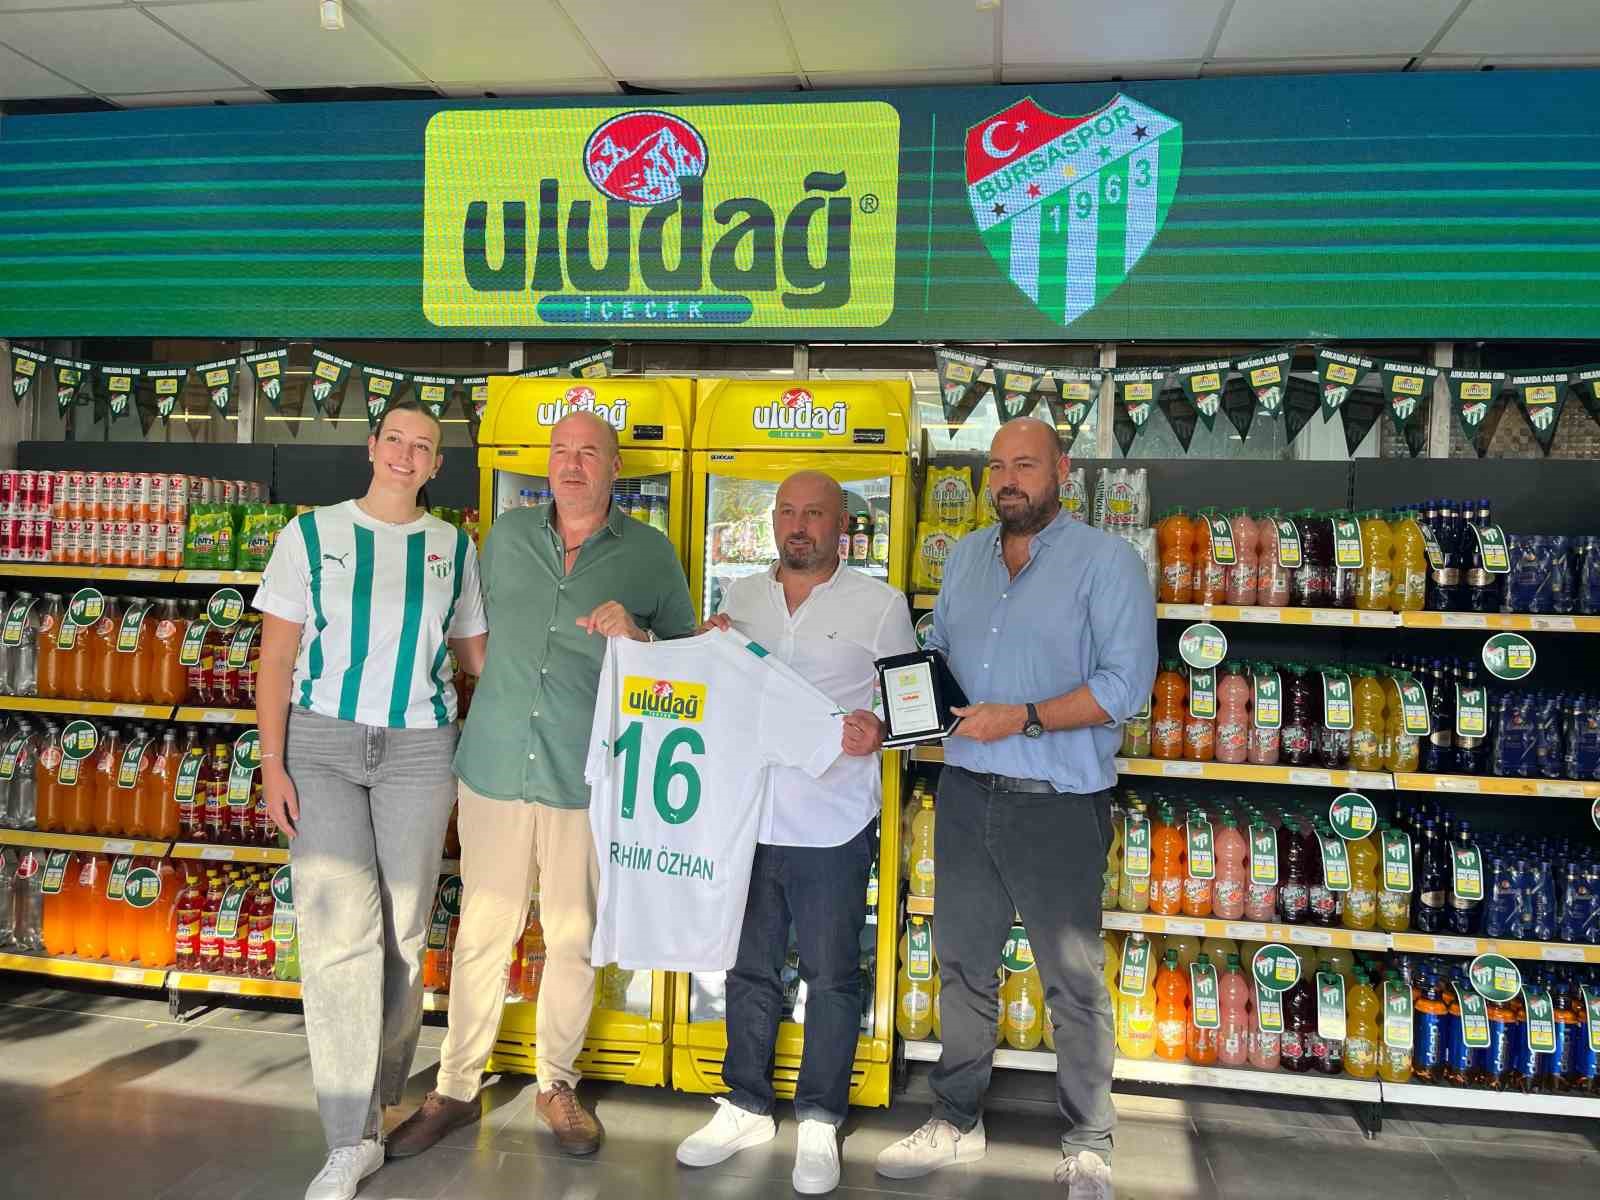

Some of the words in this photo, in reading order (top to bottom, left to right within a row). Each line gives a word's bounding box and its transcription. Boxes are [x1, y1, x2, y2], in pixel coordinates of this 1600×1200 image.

[975, 105, 1136, 201] BURSASPOR
[464, 171, 852, 309] uludağ
[753, 402, 845, 434] uludağ
[629, 690, 698, 718] uludağ
[613, 720, 706, 825] 16
[656, 845, 714, 880] ÖZHAN
